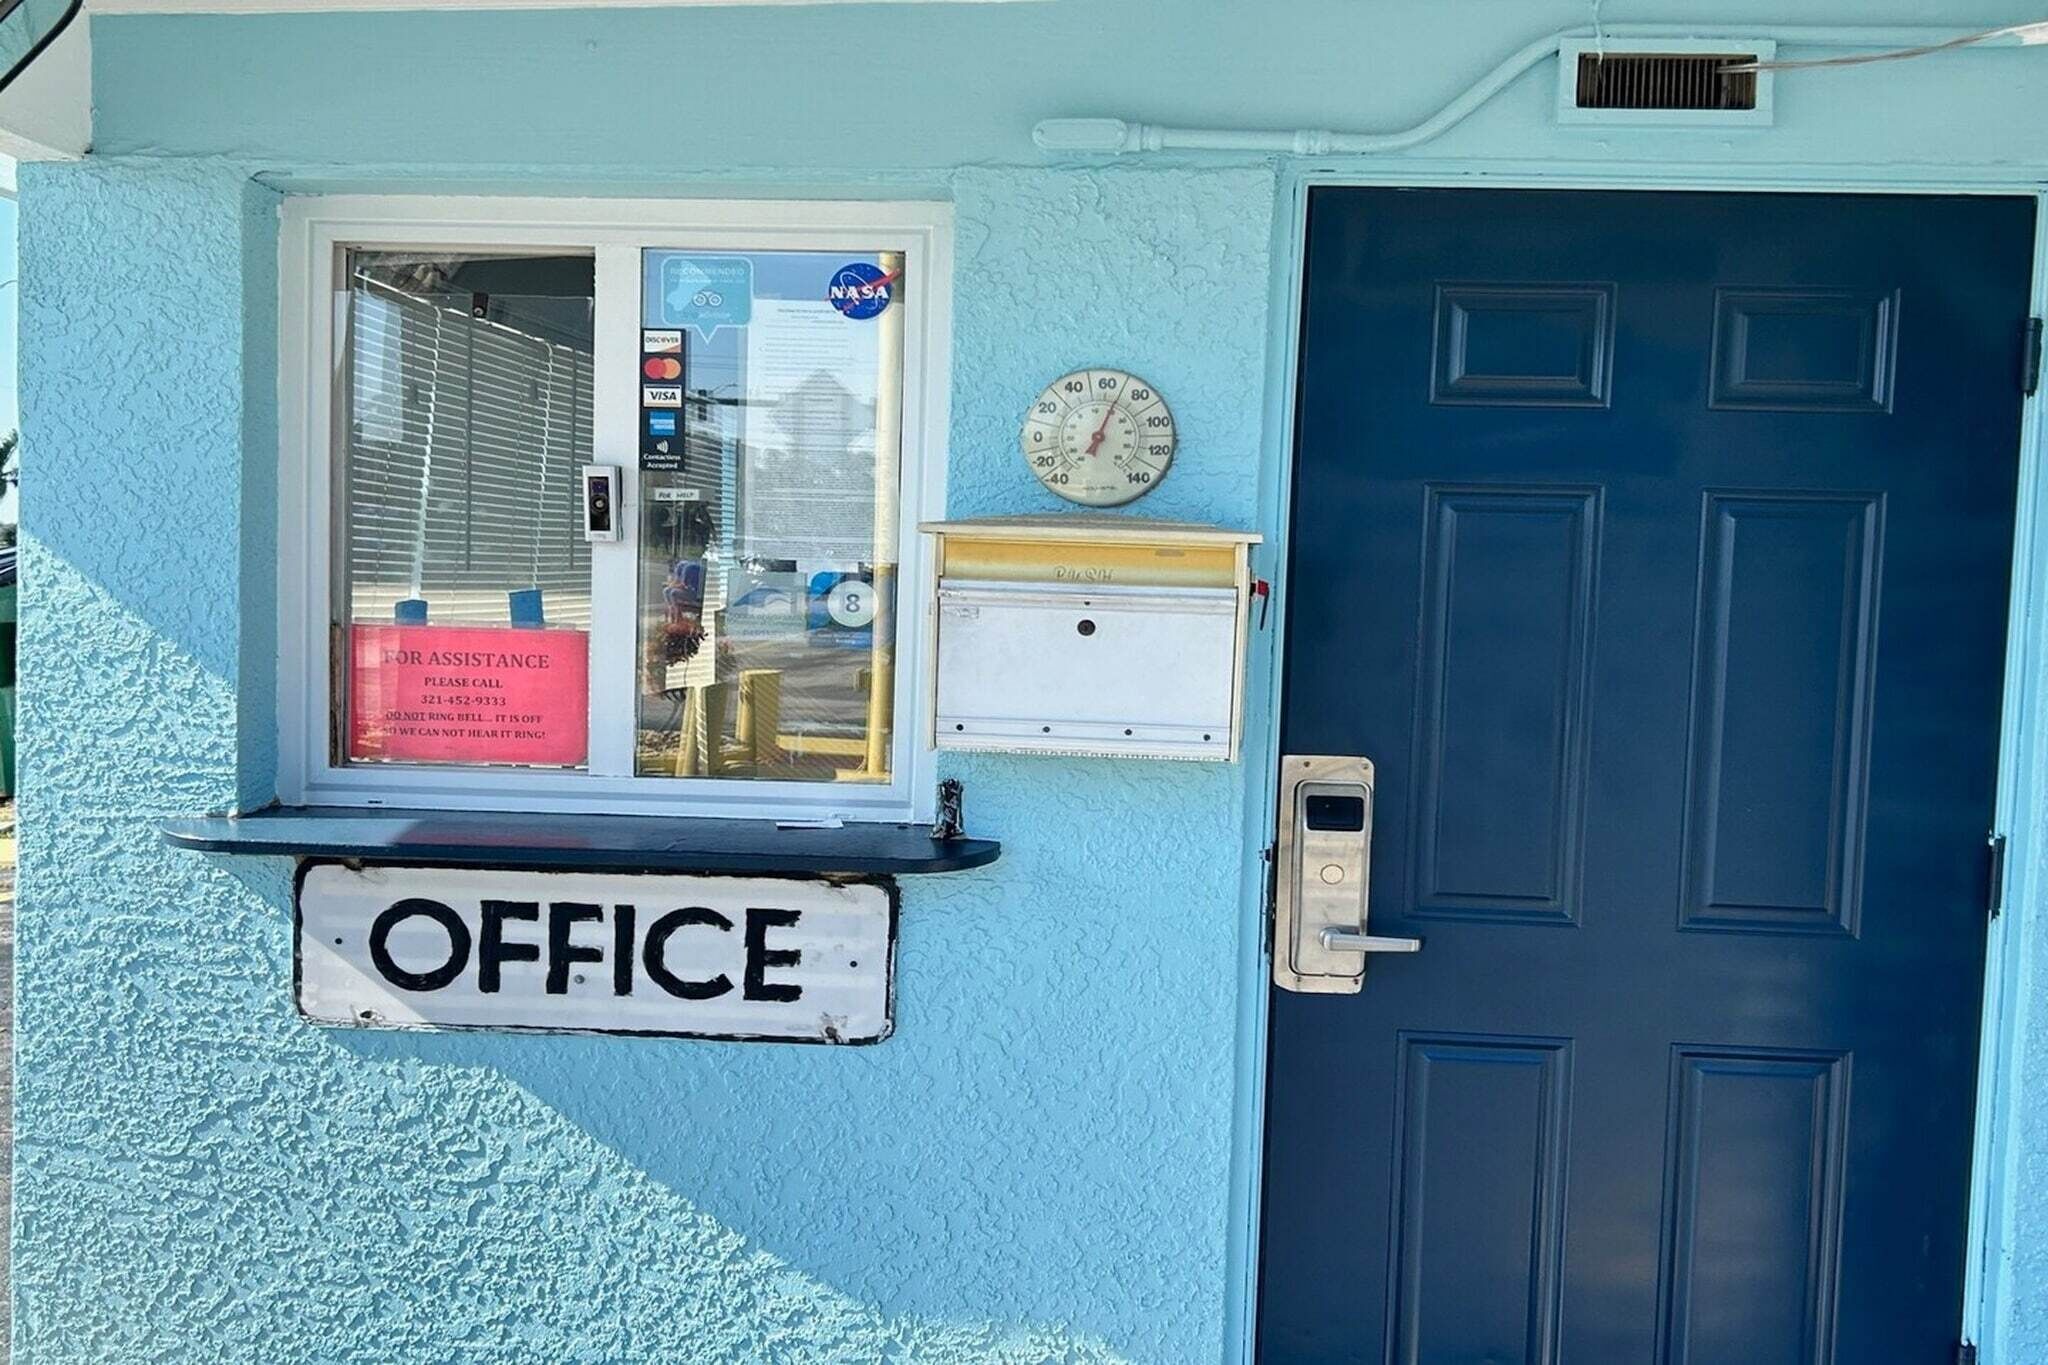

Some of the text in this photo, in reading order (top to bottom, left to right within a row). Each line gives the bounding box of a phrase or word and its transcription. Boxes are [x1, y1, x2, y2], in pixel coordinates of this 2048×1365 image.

[831, 286, 889, 299] NASA
[1064, 381, 1083, 393] 40
[1098, 377, 1117, 390] 60
[649, 391, 677, 401] VISA
[1131, 389, 1149, 401] 80
[1038, 402, 1056, 414] 20
[1147, 416, 1169, 428] 100
[1033, 431, 1043, 443] 0
[1149, 444, 1170, 456] 120
[646, 462, 678, 470] Accepted
[1032, 455, 1055, 467] -20
[1045, 473, 1069, 485] -40
[1126, 472, 1150, 484] 140
[845, 594, 860, 613] 8
[384, 650, 550, 669] FOR ASSISTANCE
[424, 677, 503, 689] PLEASE CALL
[421, 694, 506, 706] 321-452-9333
[403, 711, 426, 722] NOT
[428, 712, 454, 721] RING
[495, 714, 506, 722] IT
[509, 714, 520, 723] IS
[521, 715, 543, 723] OFF
[399, 727, 417, 736] WE
[418, 728, 439, 736] CAN
[442, 728, 464, 737] NOT
[468, 729, 498, 738] HEAR
[501, 730, 512, 738] IT
[369, 898, 802, 1002] OFFICE
